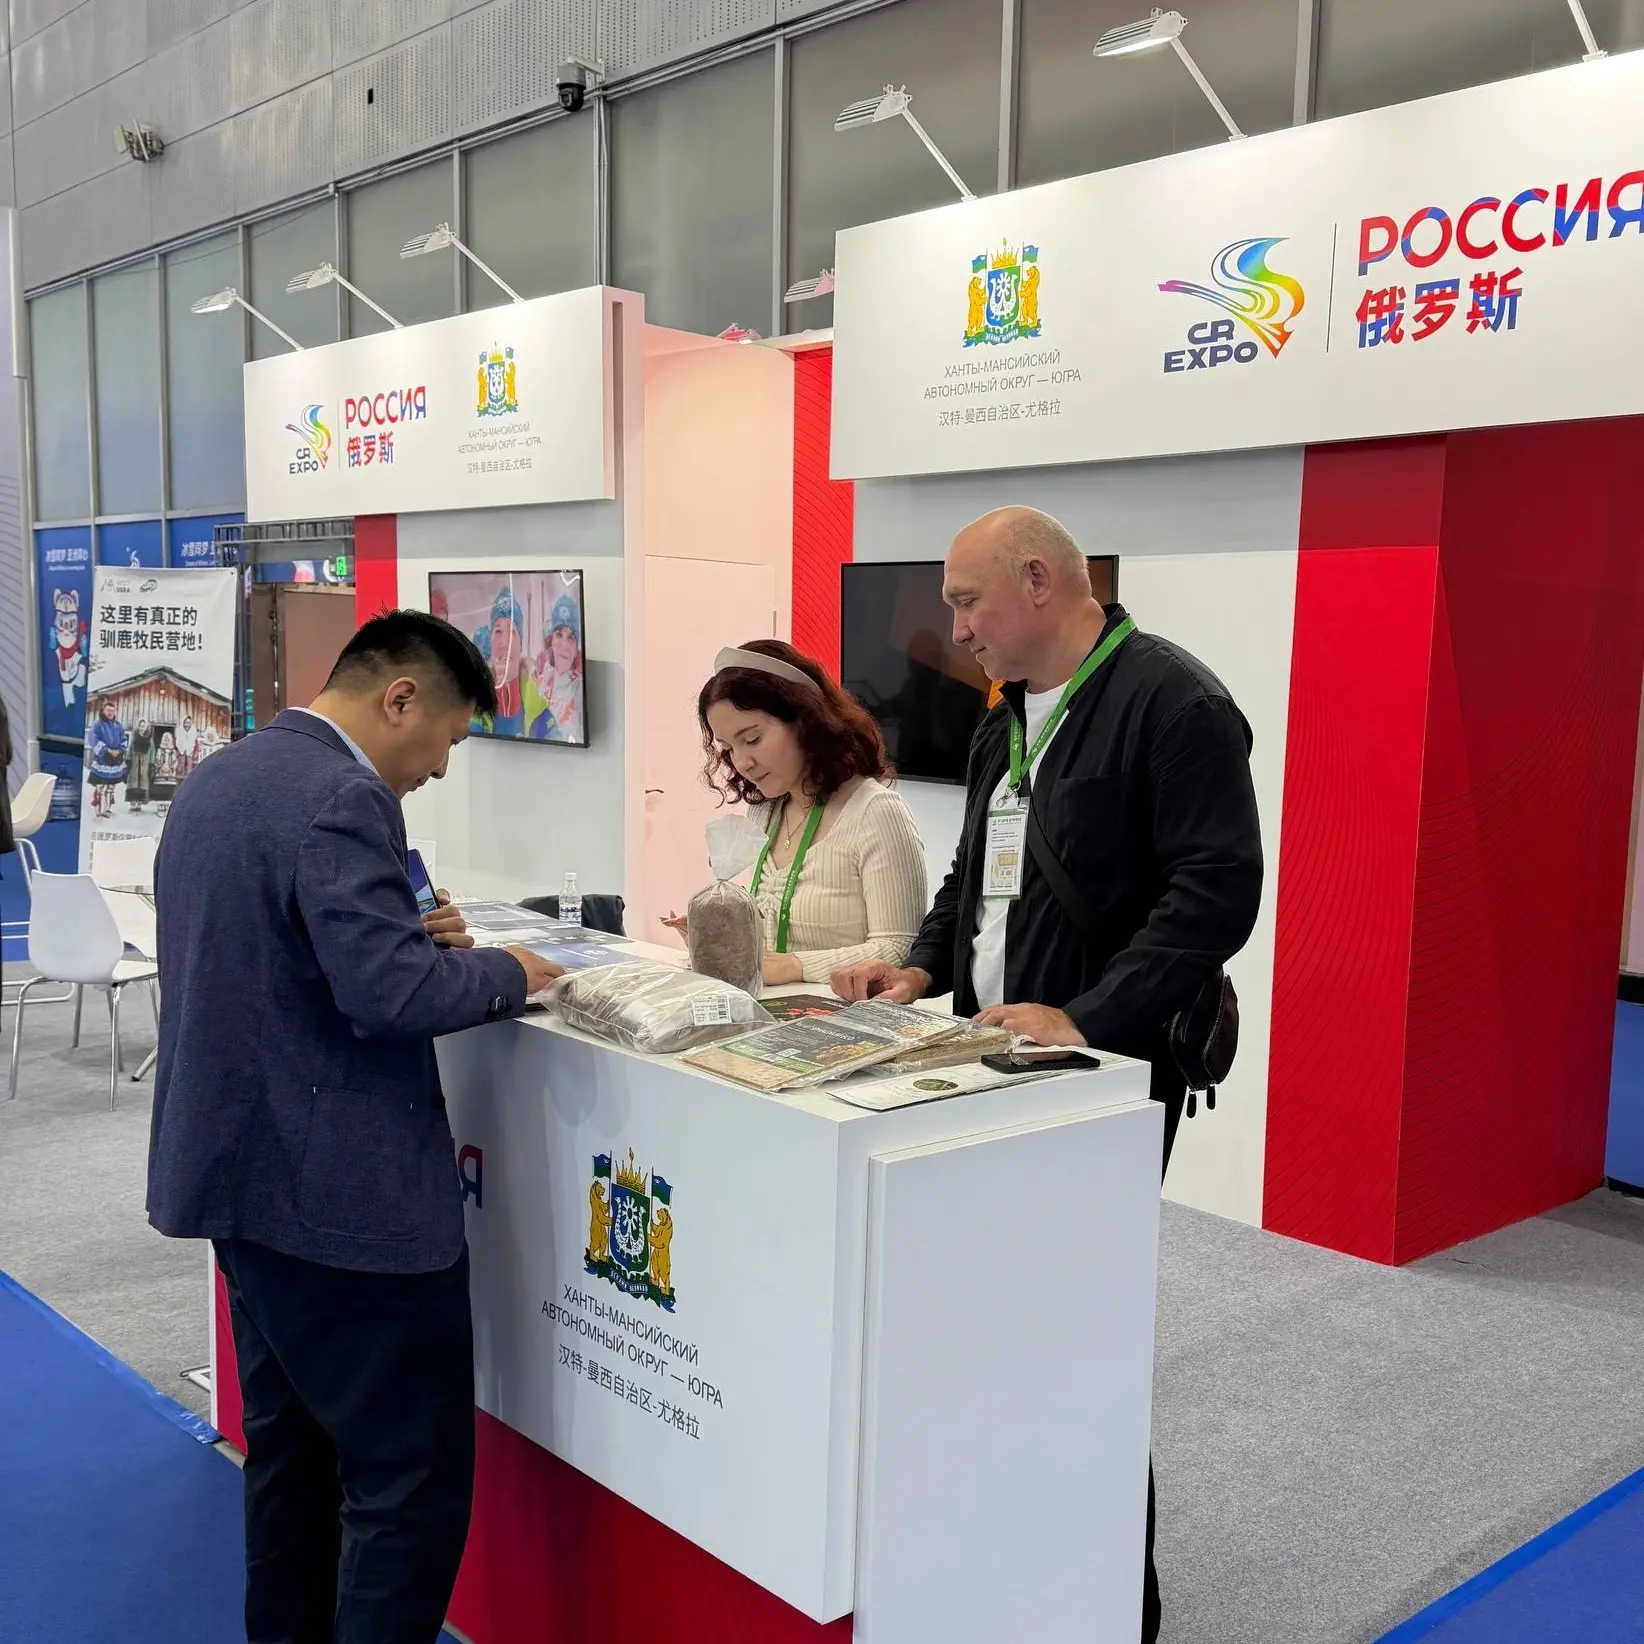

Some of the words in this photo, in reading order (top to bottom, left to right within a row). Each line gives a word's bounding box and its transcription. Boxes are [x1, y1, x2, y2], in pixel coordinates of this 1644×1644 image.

[1358, 170, 1644, 276] РОССИЯ
[1355, 267, 1523, 349] 俄罗斯
[944, 349, 1061, 378] ХАНТЫ-МАНСИЙСКИЙ
[1163, 341, 1258, 373] EXPO
[924, 377, 997, 399] АВТОНОМНЫЙ
[1000, 374, 1035, 391] ОКРУГ
[1051, 369, 1081, 384] ЮГРА
[345, 386, 426, 429] РОССИЯ
[938, 399, 1061, 427] 汉特-曼西自治区-尤格拉
[347, 431, 394, 468] 俄罗斯
[289, 460, 319, 474] EXPO
[100, 605, 198, 626] 这里有真正的
[99, 629, 203, 651] 驯鹿牧民营地！
[563, 1284, 698, 1366] ХАНТЫ-МАНСИЙСКИЙ
[541, 1301, 624, 1355] АВТОНОМНЫЙ
[627, 1344, 669, 1376] ОКРУГ
[687, 1375, 723, 1408] ЮГРА
[558, 1343, 700, 1440] 汉特-曼西自治区-尤格拉
